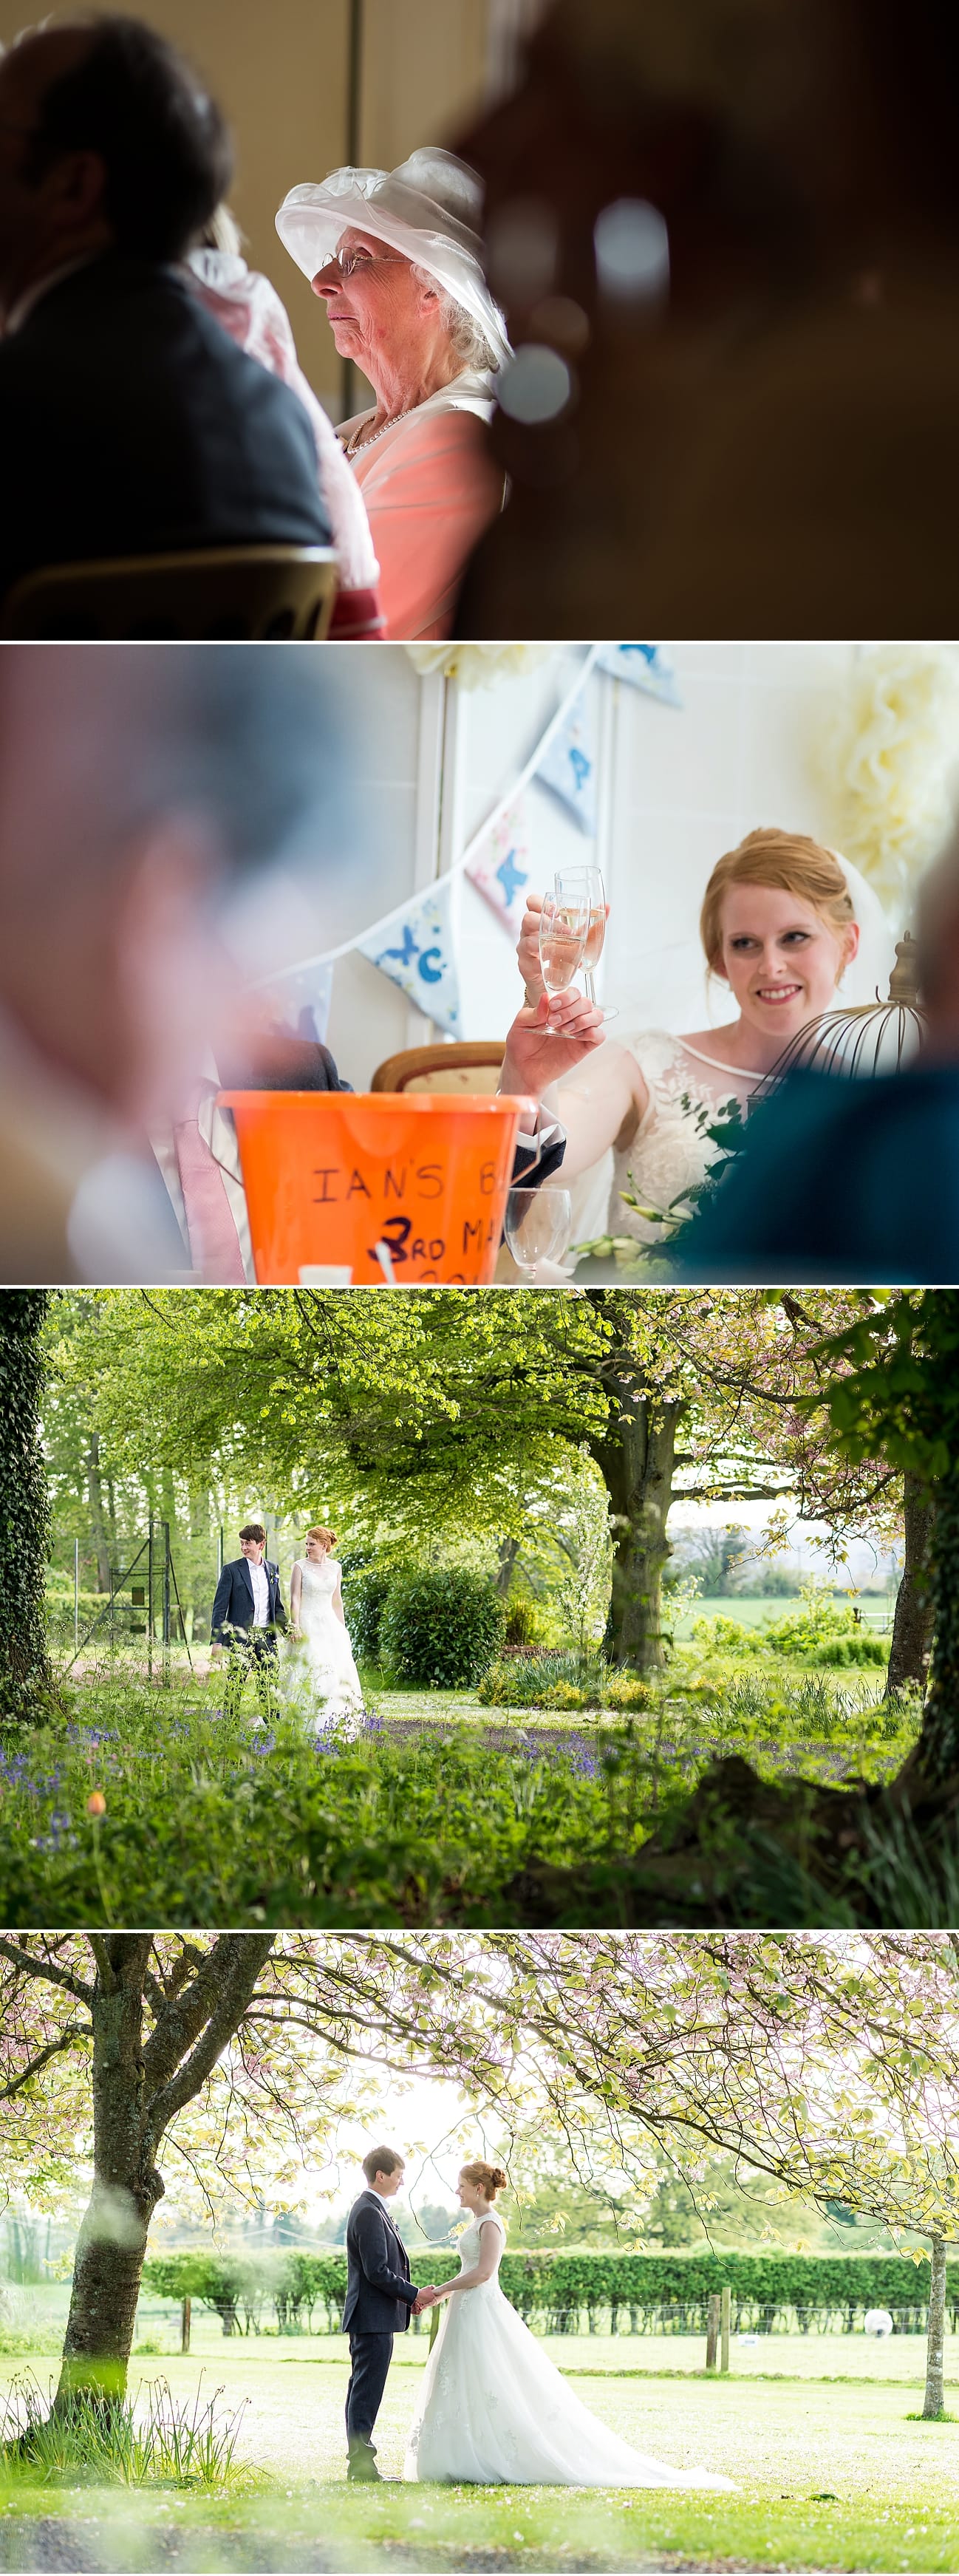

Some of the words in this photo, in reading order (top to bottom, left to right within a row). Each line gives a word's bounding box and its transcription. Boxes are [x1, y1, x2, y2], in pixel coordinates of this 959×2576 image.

[313, 1159, 445, 1203] IAN'S
[480, 1161, 505, 1196] B
[367, 1216, 446, 1264] 3RD
